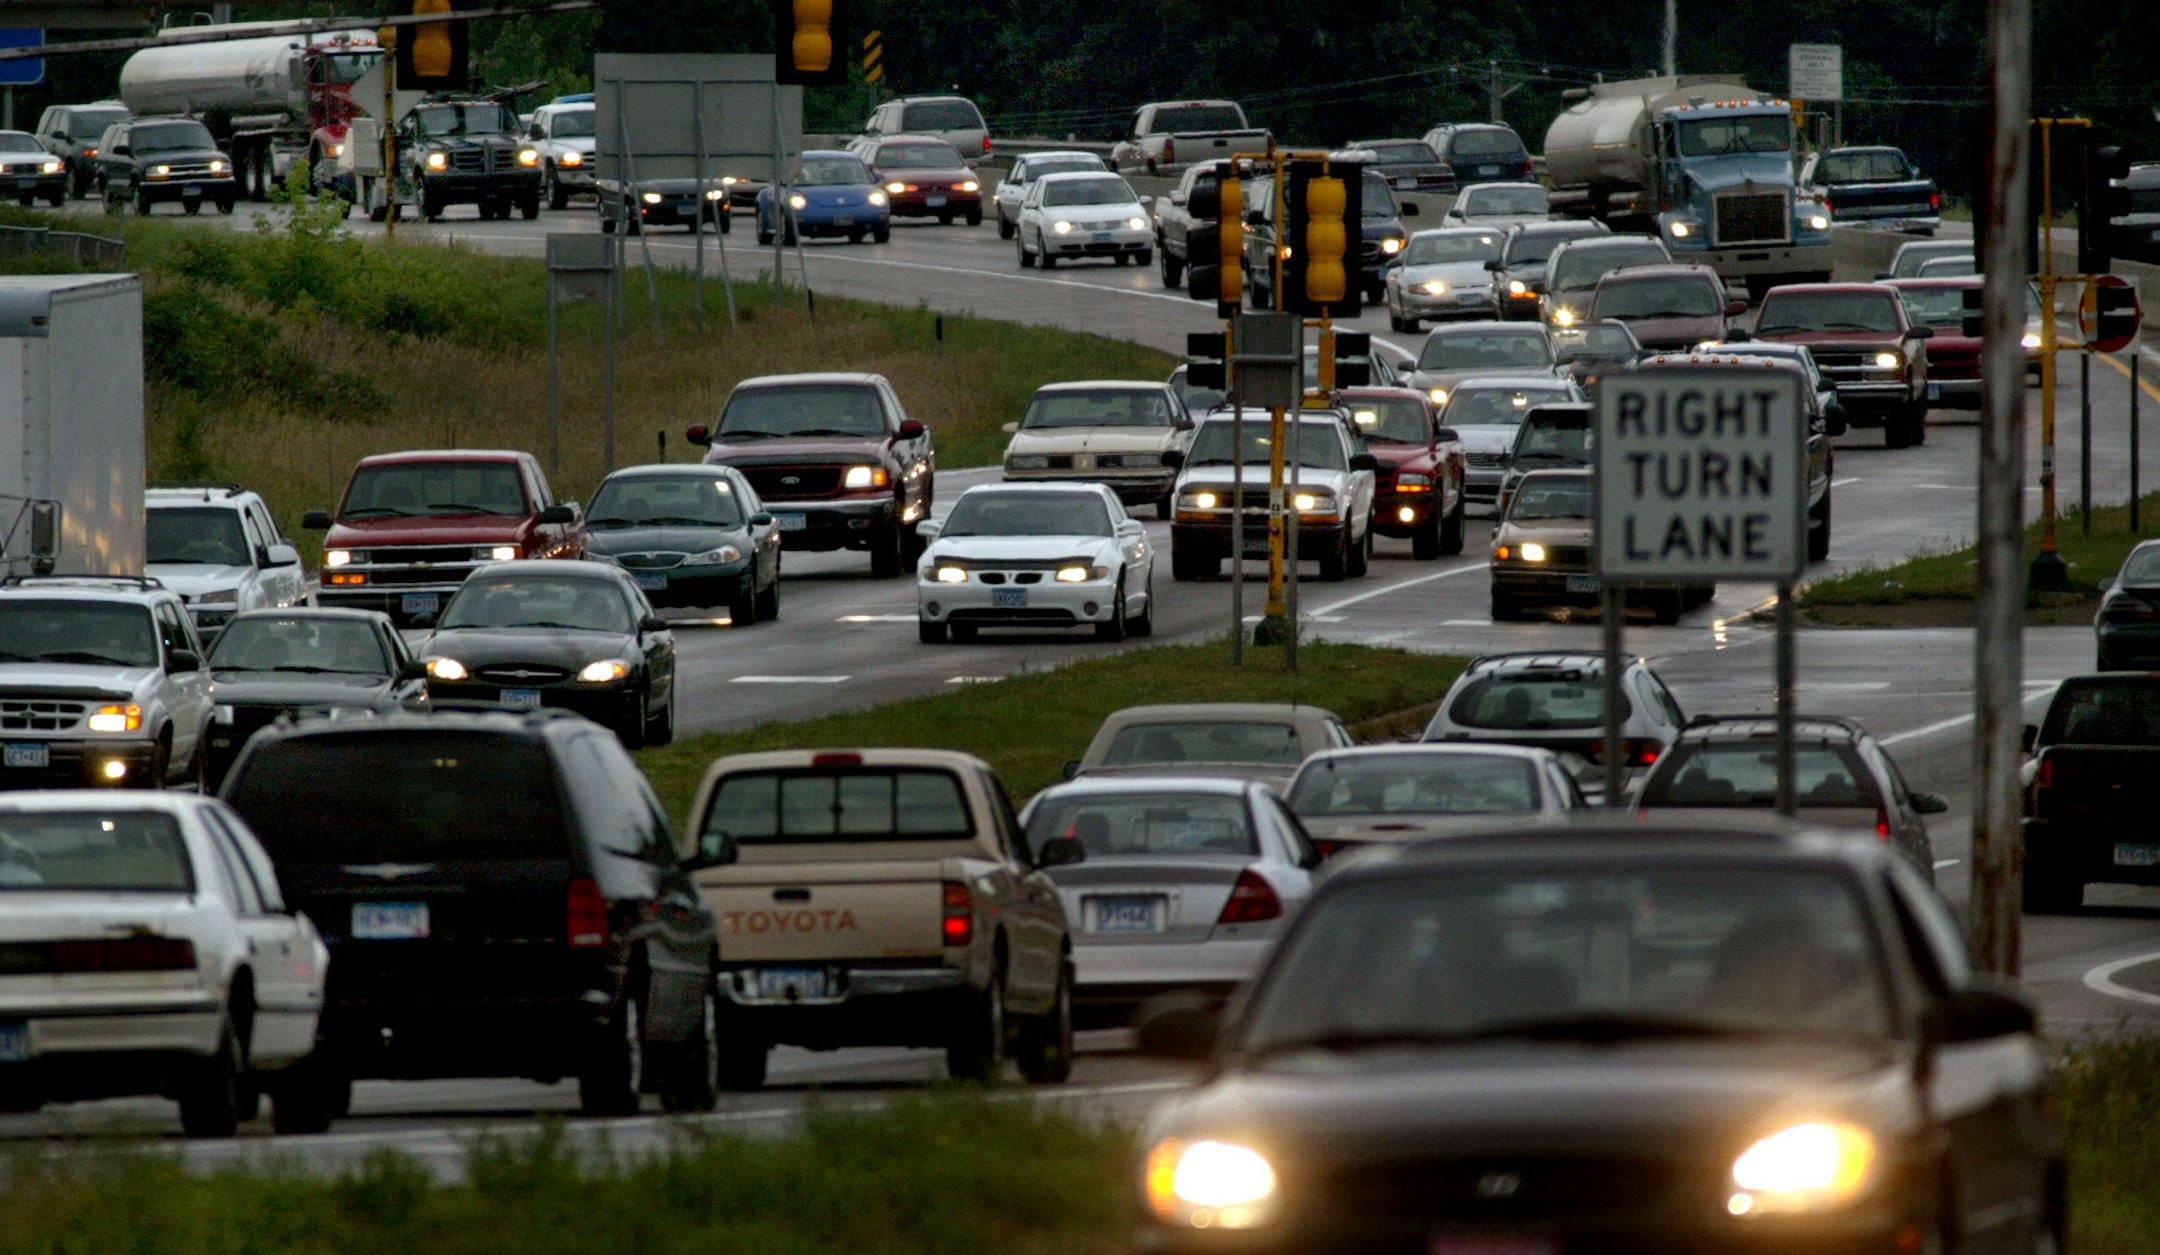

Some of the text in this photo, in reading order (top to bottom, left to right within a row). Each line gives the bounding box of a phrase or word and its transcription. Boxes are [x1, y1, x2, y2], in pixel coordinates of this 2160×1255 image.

[1616, 390, 1779, 437] RIGHT
[1626, 451, 1773, 498] TURN
[1624, 514, 1771, 561] LANE
[726, 909, 857, 934] TOYOTA
